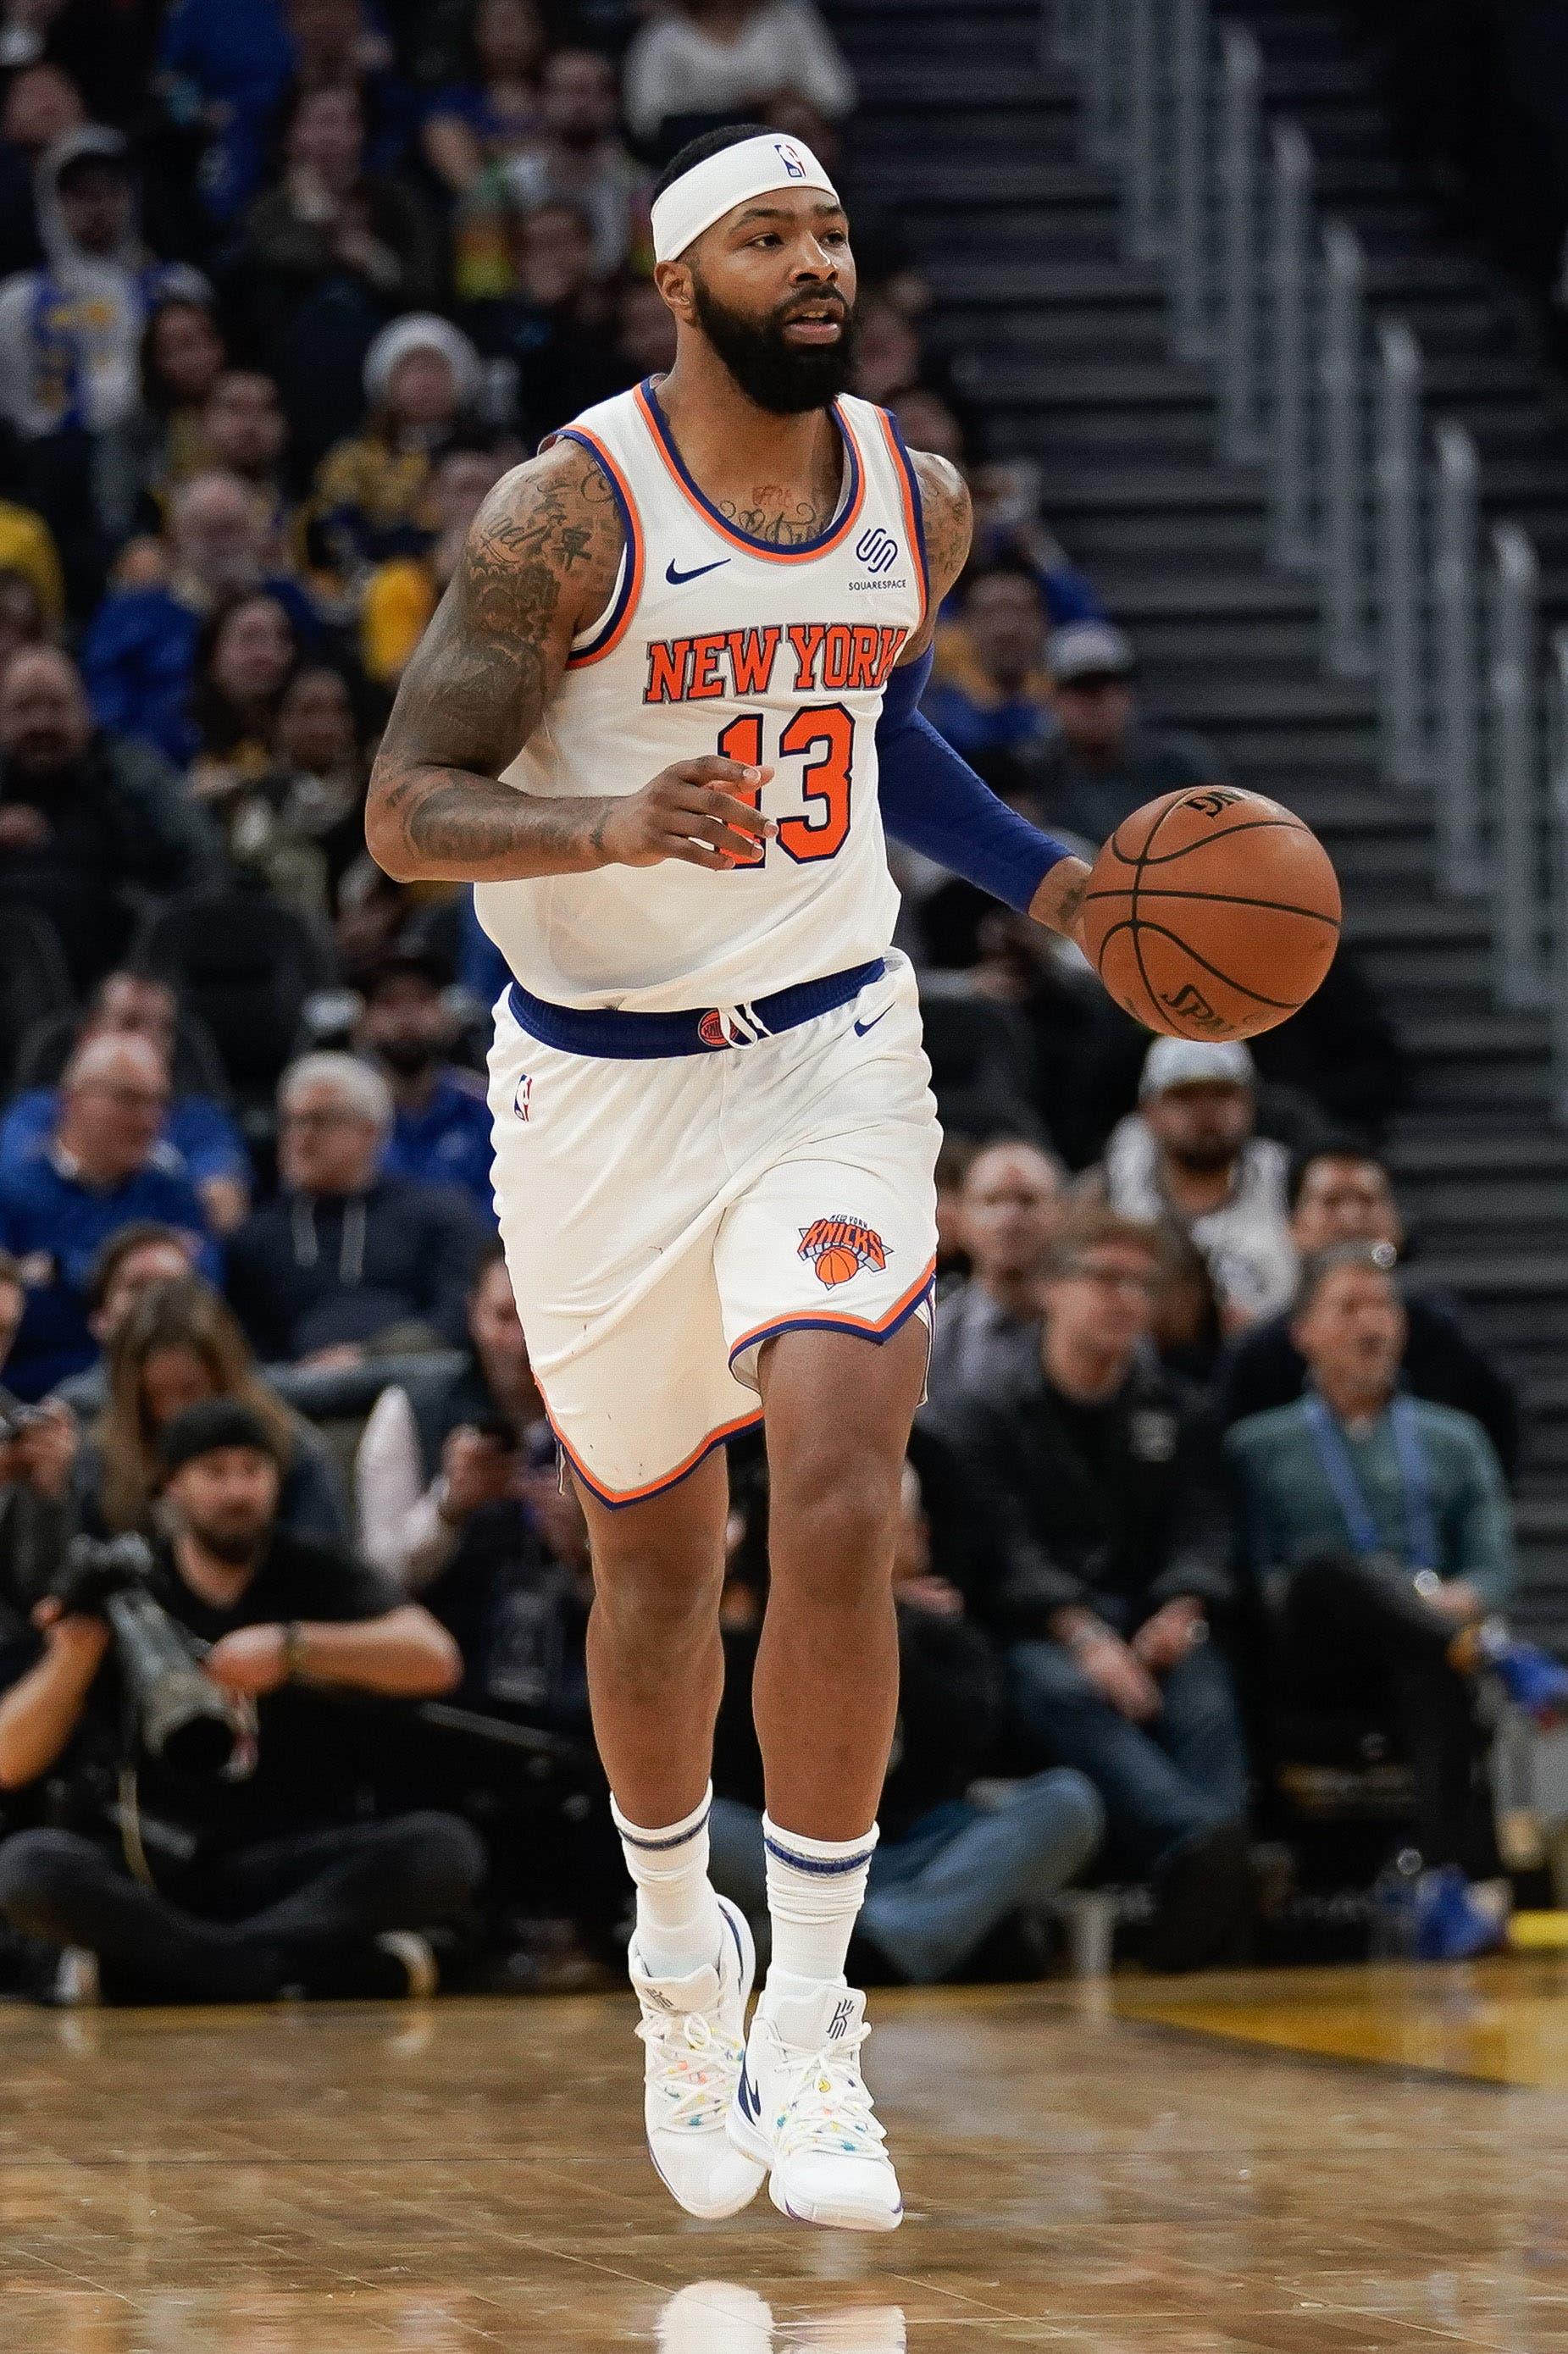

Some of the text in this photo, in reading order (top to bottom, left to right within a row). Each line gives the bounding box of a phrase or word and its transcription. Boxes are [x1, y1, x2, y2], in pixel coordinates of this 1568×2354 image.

[848, 579, 906, 591] SQUARESPACE
[643, 623, 909, 705] NEW YORK
[717, 702, 856, 870] 13
[797, 1218, 886, 1272] KNICKS
[829, 1213, 868, 1229] NEW YORK
